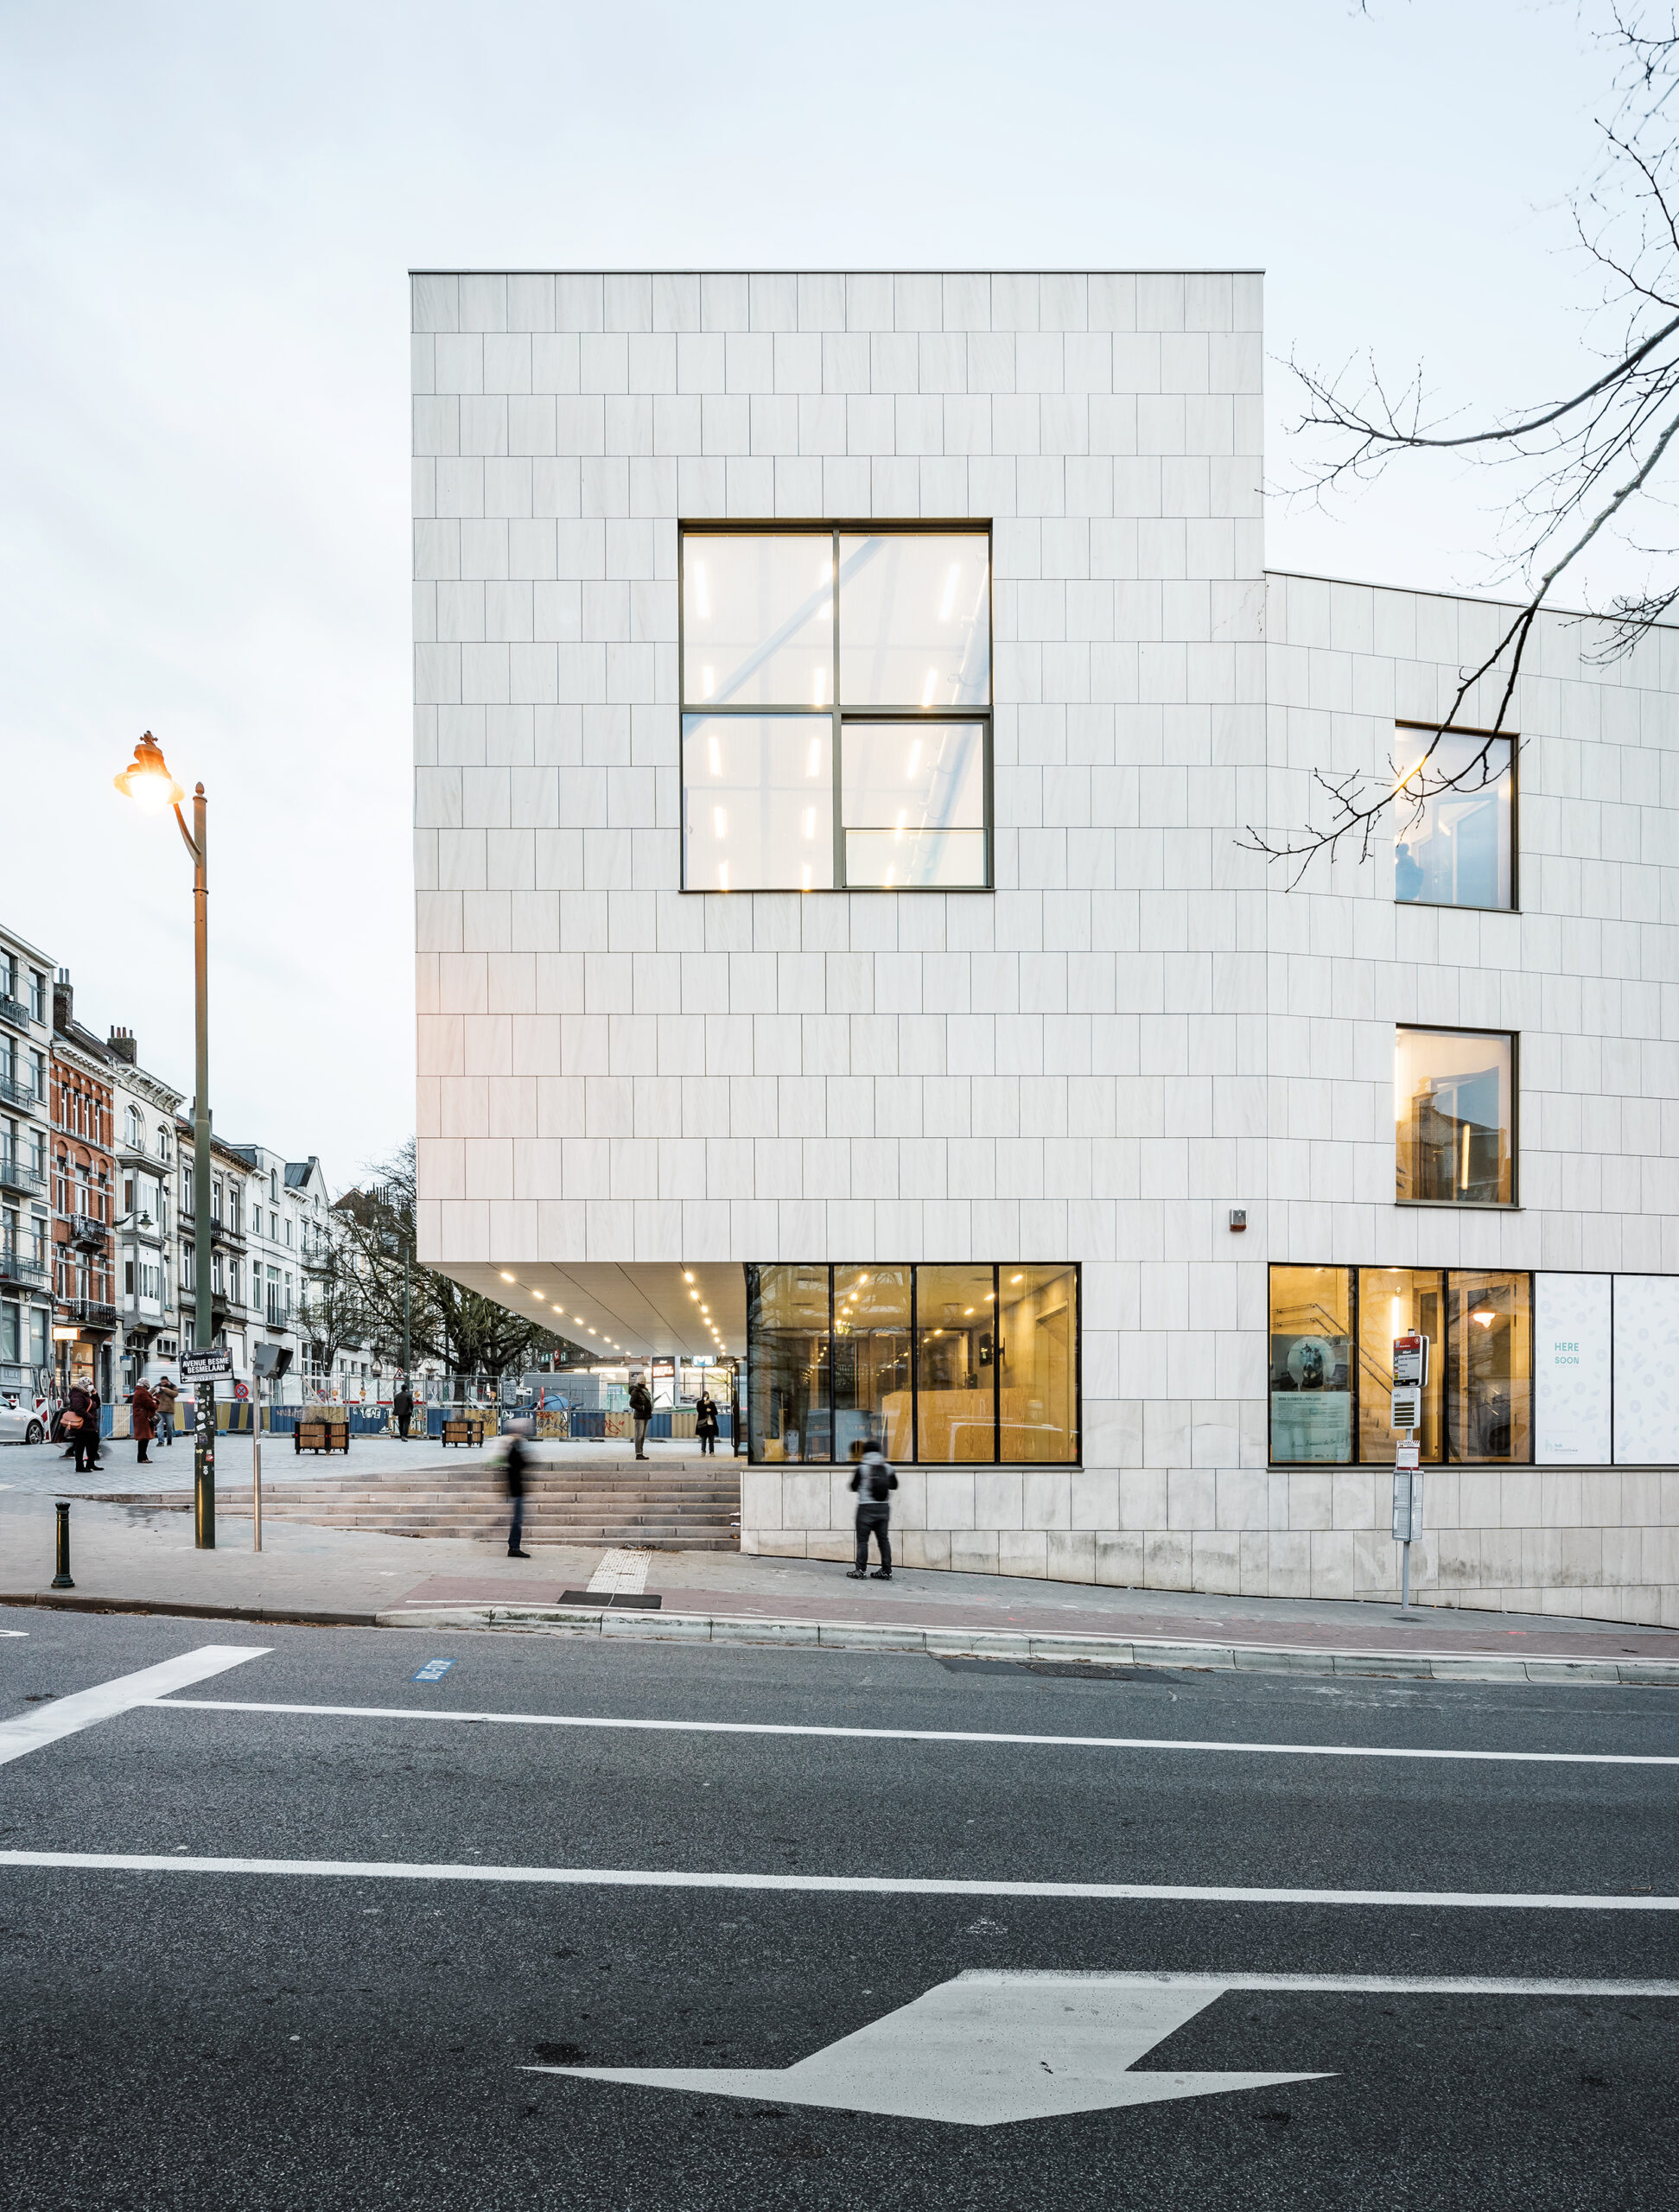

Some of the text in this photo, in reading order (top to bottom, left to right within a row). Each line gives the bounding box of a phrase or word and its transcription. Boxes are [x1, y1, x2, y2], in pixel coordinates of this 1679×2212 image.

[1555, 1342, 1580, 1351] HERE
[182, 1357, 230, 1368] AVENUE BESME
[1555, 1356, 1580, 1364] SOON
[188, 1364, 225, 1374] BESMELAAN
